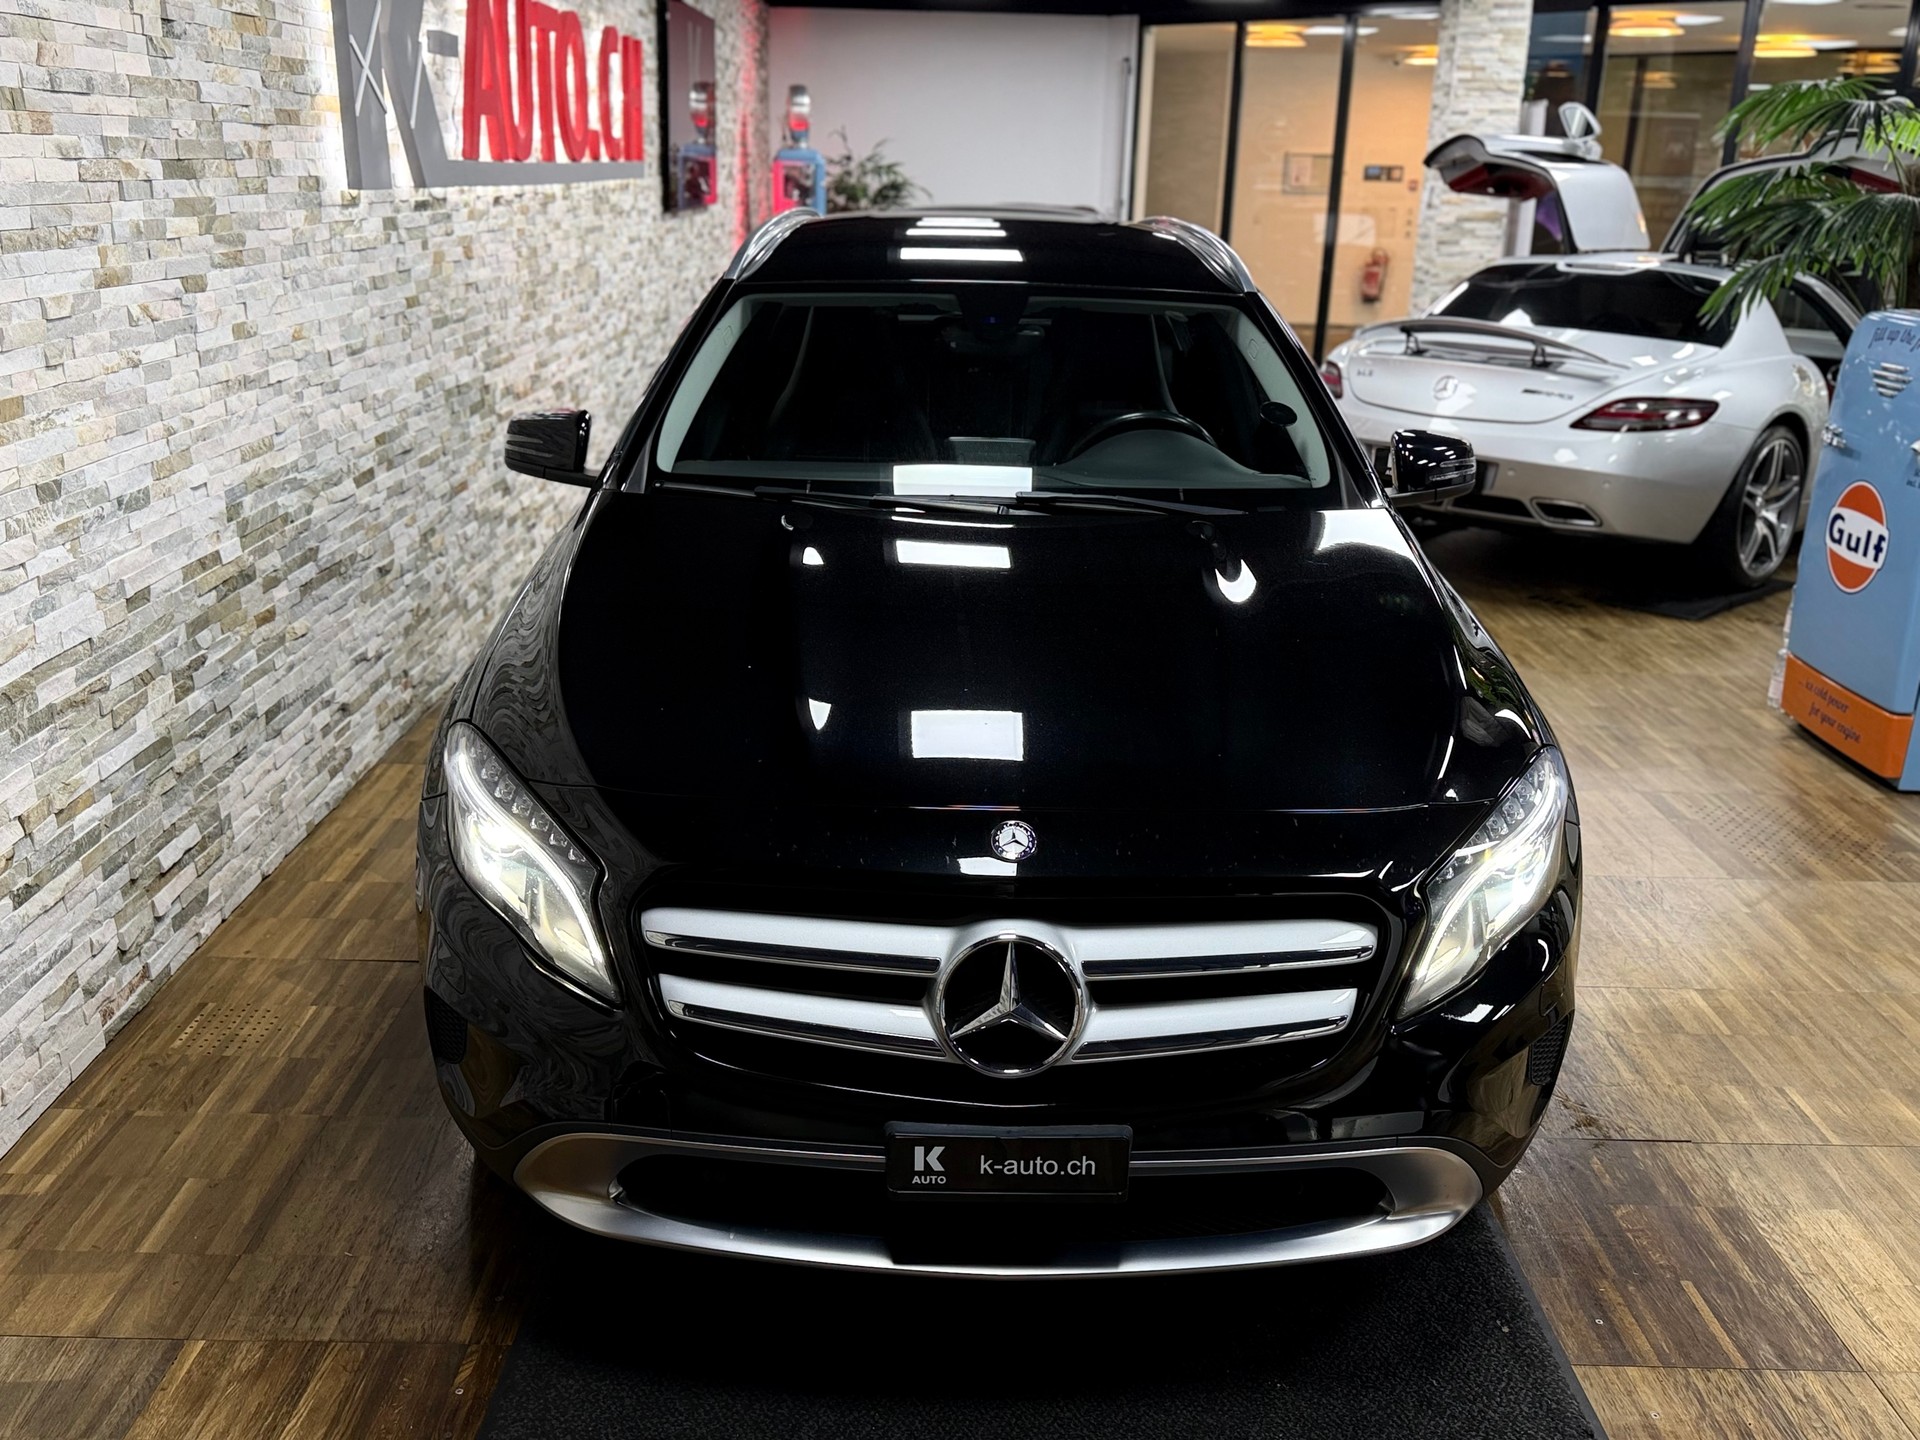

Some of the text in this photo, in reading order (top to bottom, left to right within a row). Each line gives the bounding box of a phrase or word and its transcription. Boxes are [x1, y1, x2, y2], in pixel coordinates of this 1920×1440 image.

[1828, 512, 1887, 563] Gulf
[914, 1146, 946, 1172] K
[980, 1154, 1096, 1176] k-auto.ch
[911, 1175, 947, 1185] AUTO
